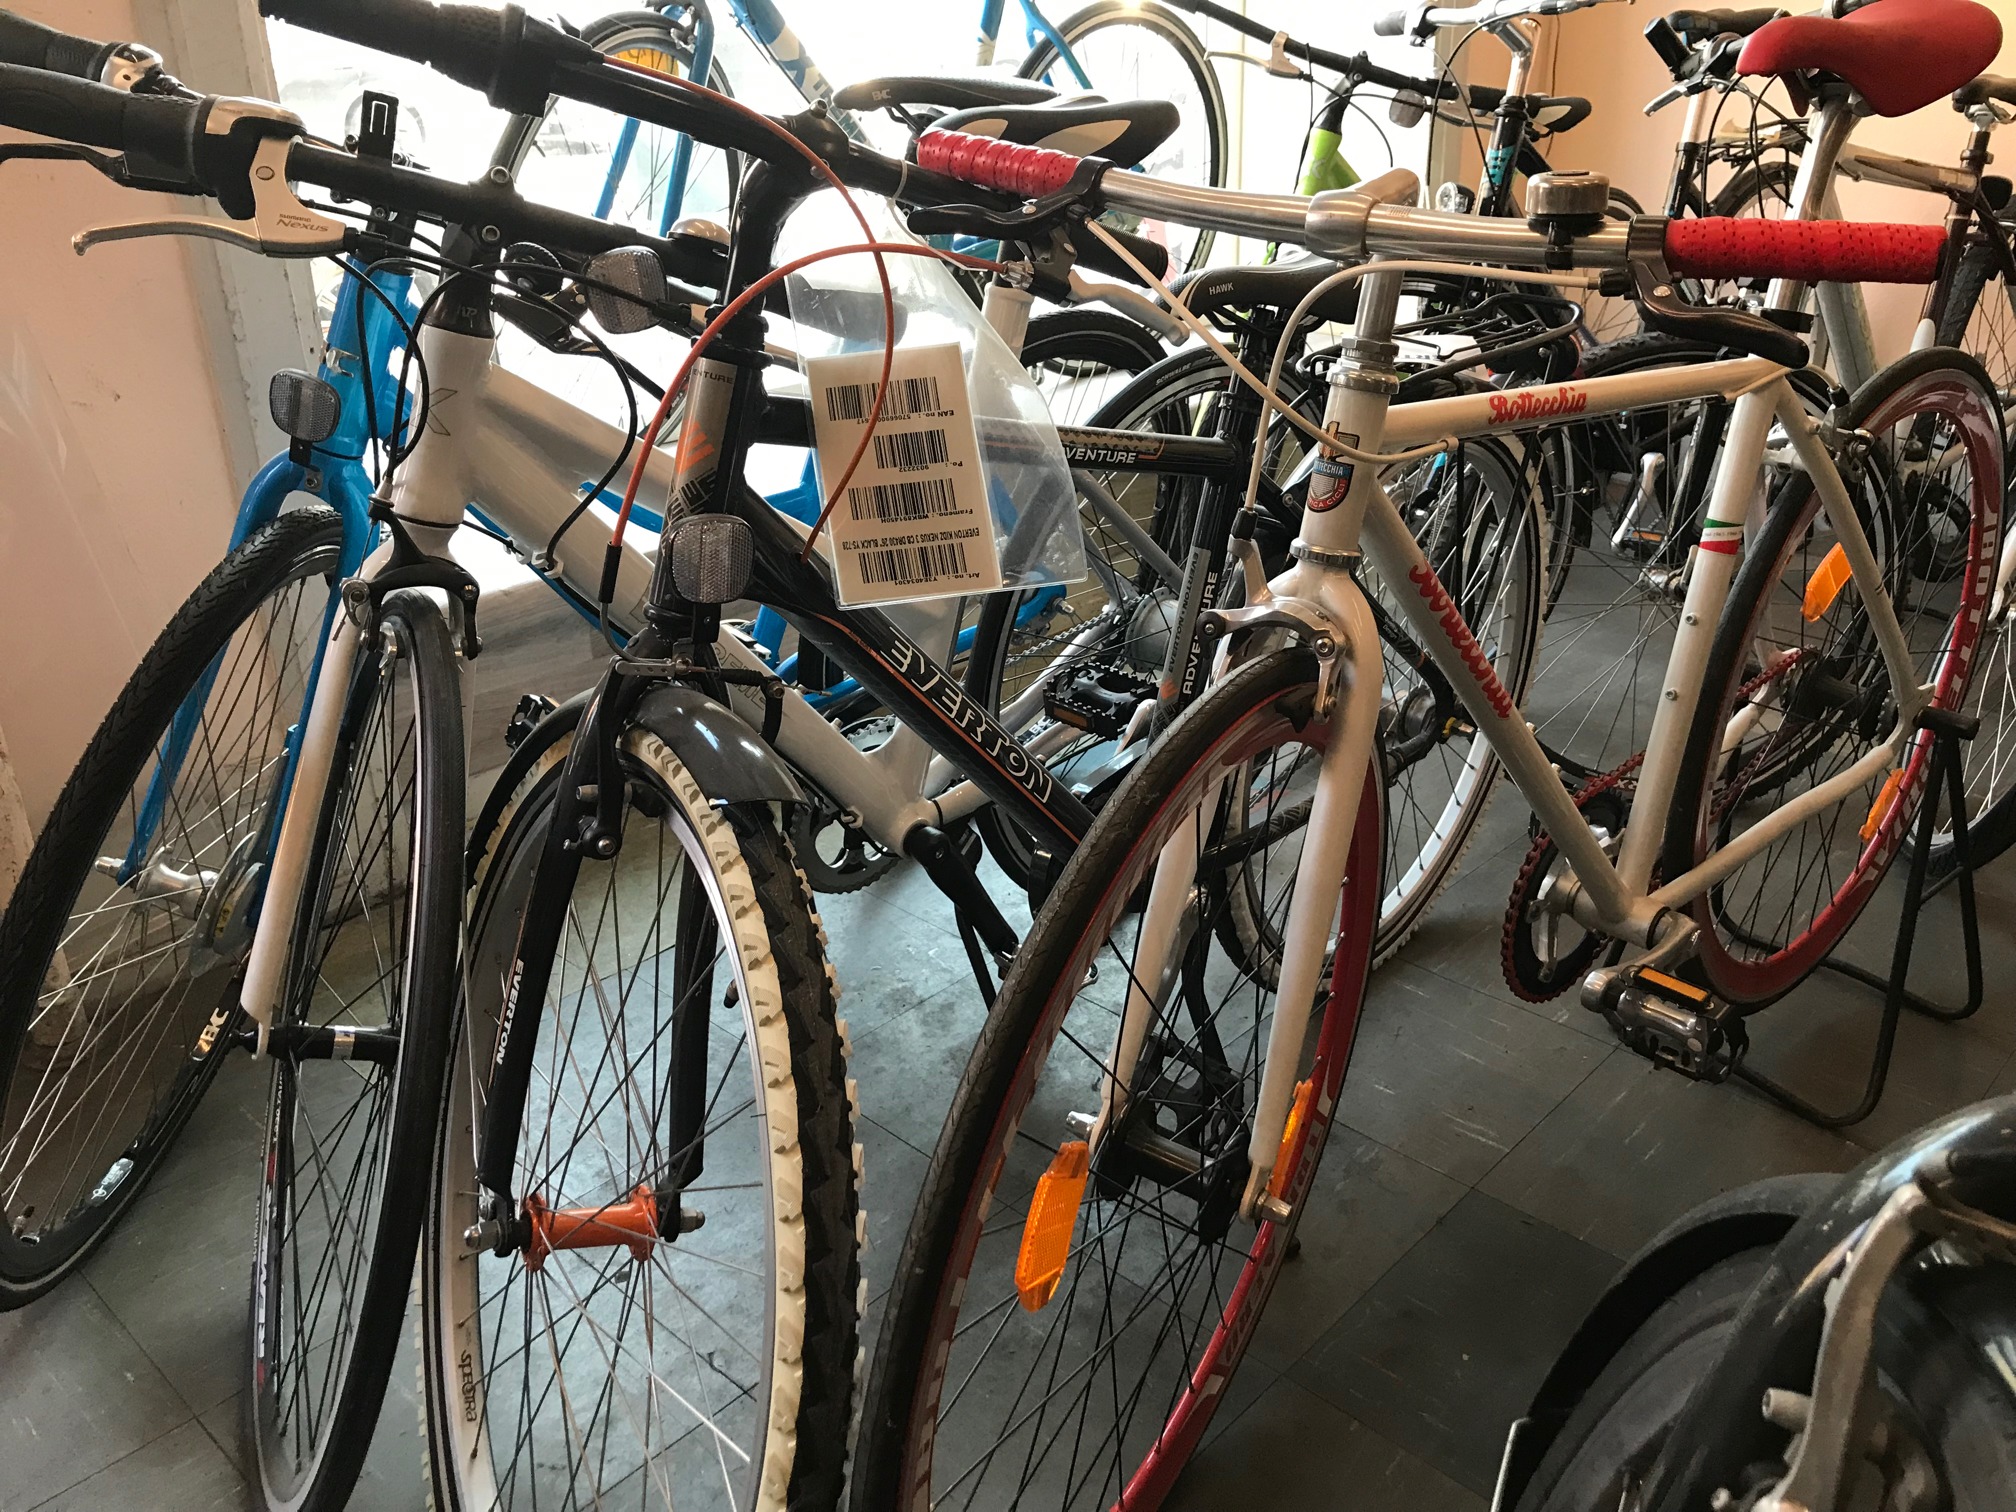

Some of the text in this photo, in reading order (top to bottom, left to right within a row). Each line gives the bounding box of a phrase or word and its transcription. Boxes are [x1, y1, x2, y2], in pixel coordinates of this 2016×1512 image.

[1209, 282, 1234, 296] HAWK
[693, 368, 734, 385] ENTURE
[1488, 387, 1587, 425] Bottecchia
[938, 409, 955, 418] EAN
[1066, 446, 1137, 464] VENTURE
[899, 464, 930, 473] 9032232
[921, 532, 939, 543] NEXUS
[939, 531, 954, 541] KIDZ
[954, 527, 980, 540] EVERTON
[862, 539, 879, 549] BLACK
[879, 625, 1053, 804] EVERTON
[495, 957, 525, 1066] EVERTON
